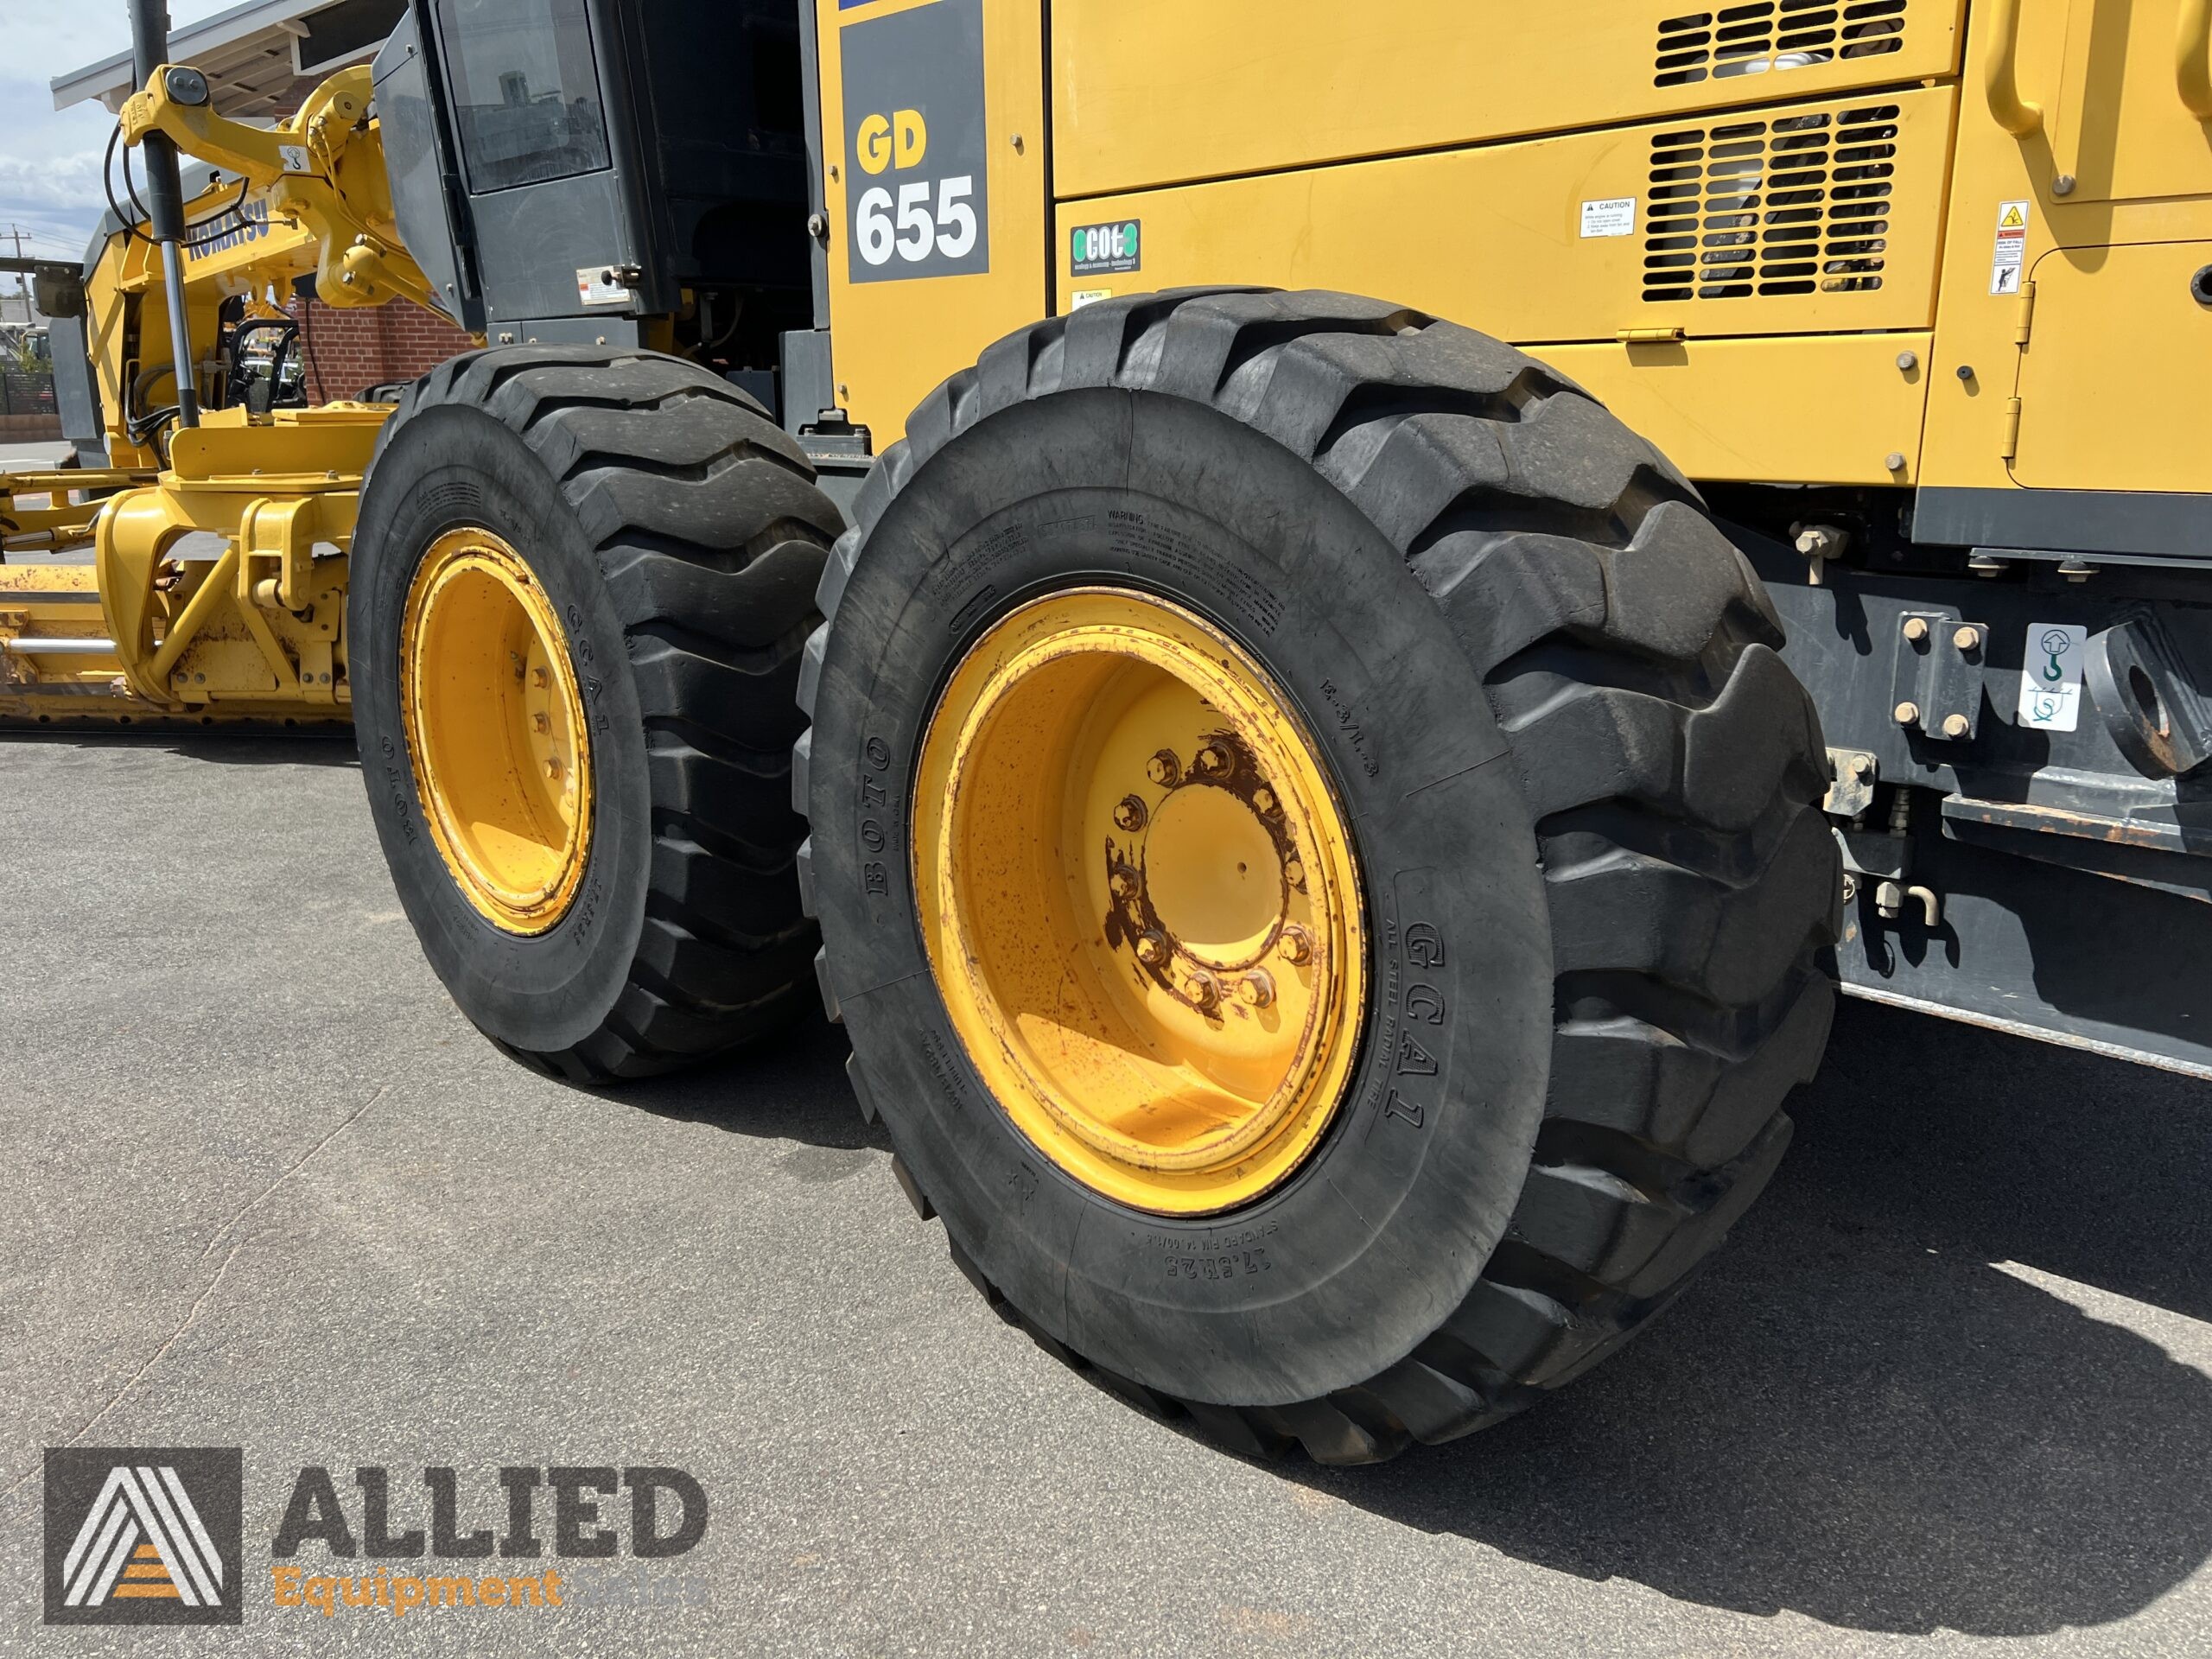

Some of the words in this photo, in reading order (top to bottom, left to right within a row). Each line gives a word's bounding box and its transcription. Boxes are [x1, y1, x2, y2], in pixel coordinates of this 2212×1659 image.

[856, 109, 927, 175] GD
[186, 199, 269, 262] KOMATSU
[855, 175, 977, 265] 655
[1599, 201, 1630, 210] CAUTION
[861, 736, 890, 897] BOTO
[1386, 918, 1398, 950] ALL
[1388, 958, 1400, 1008] STEEL
[1378, 1016, 1396, 1070] RADIAL
[1383, 920, 1446, 1128] GCA1
[1367, 1077, 1383, 1114] TIRE
[1224, 1219, 1279, 1249] STANDARD
[1164, 1245, 1272, 1280] 17.5R25
